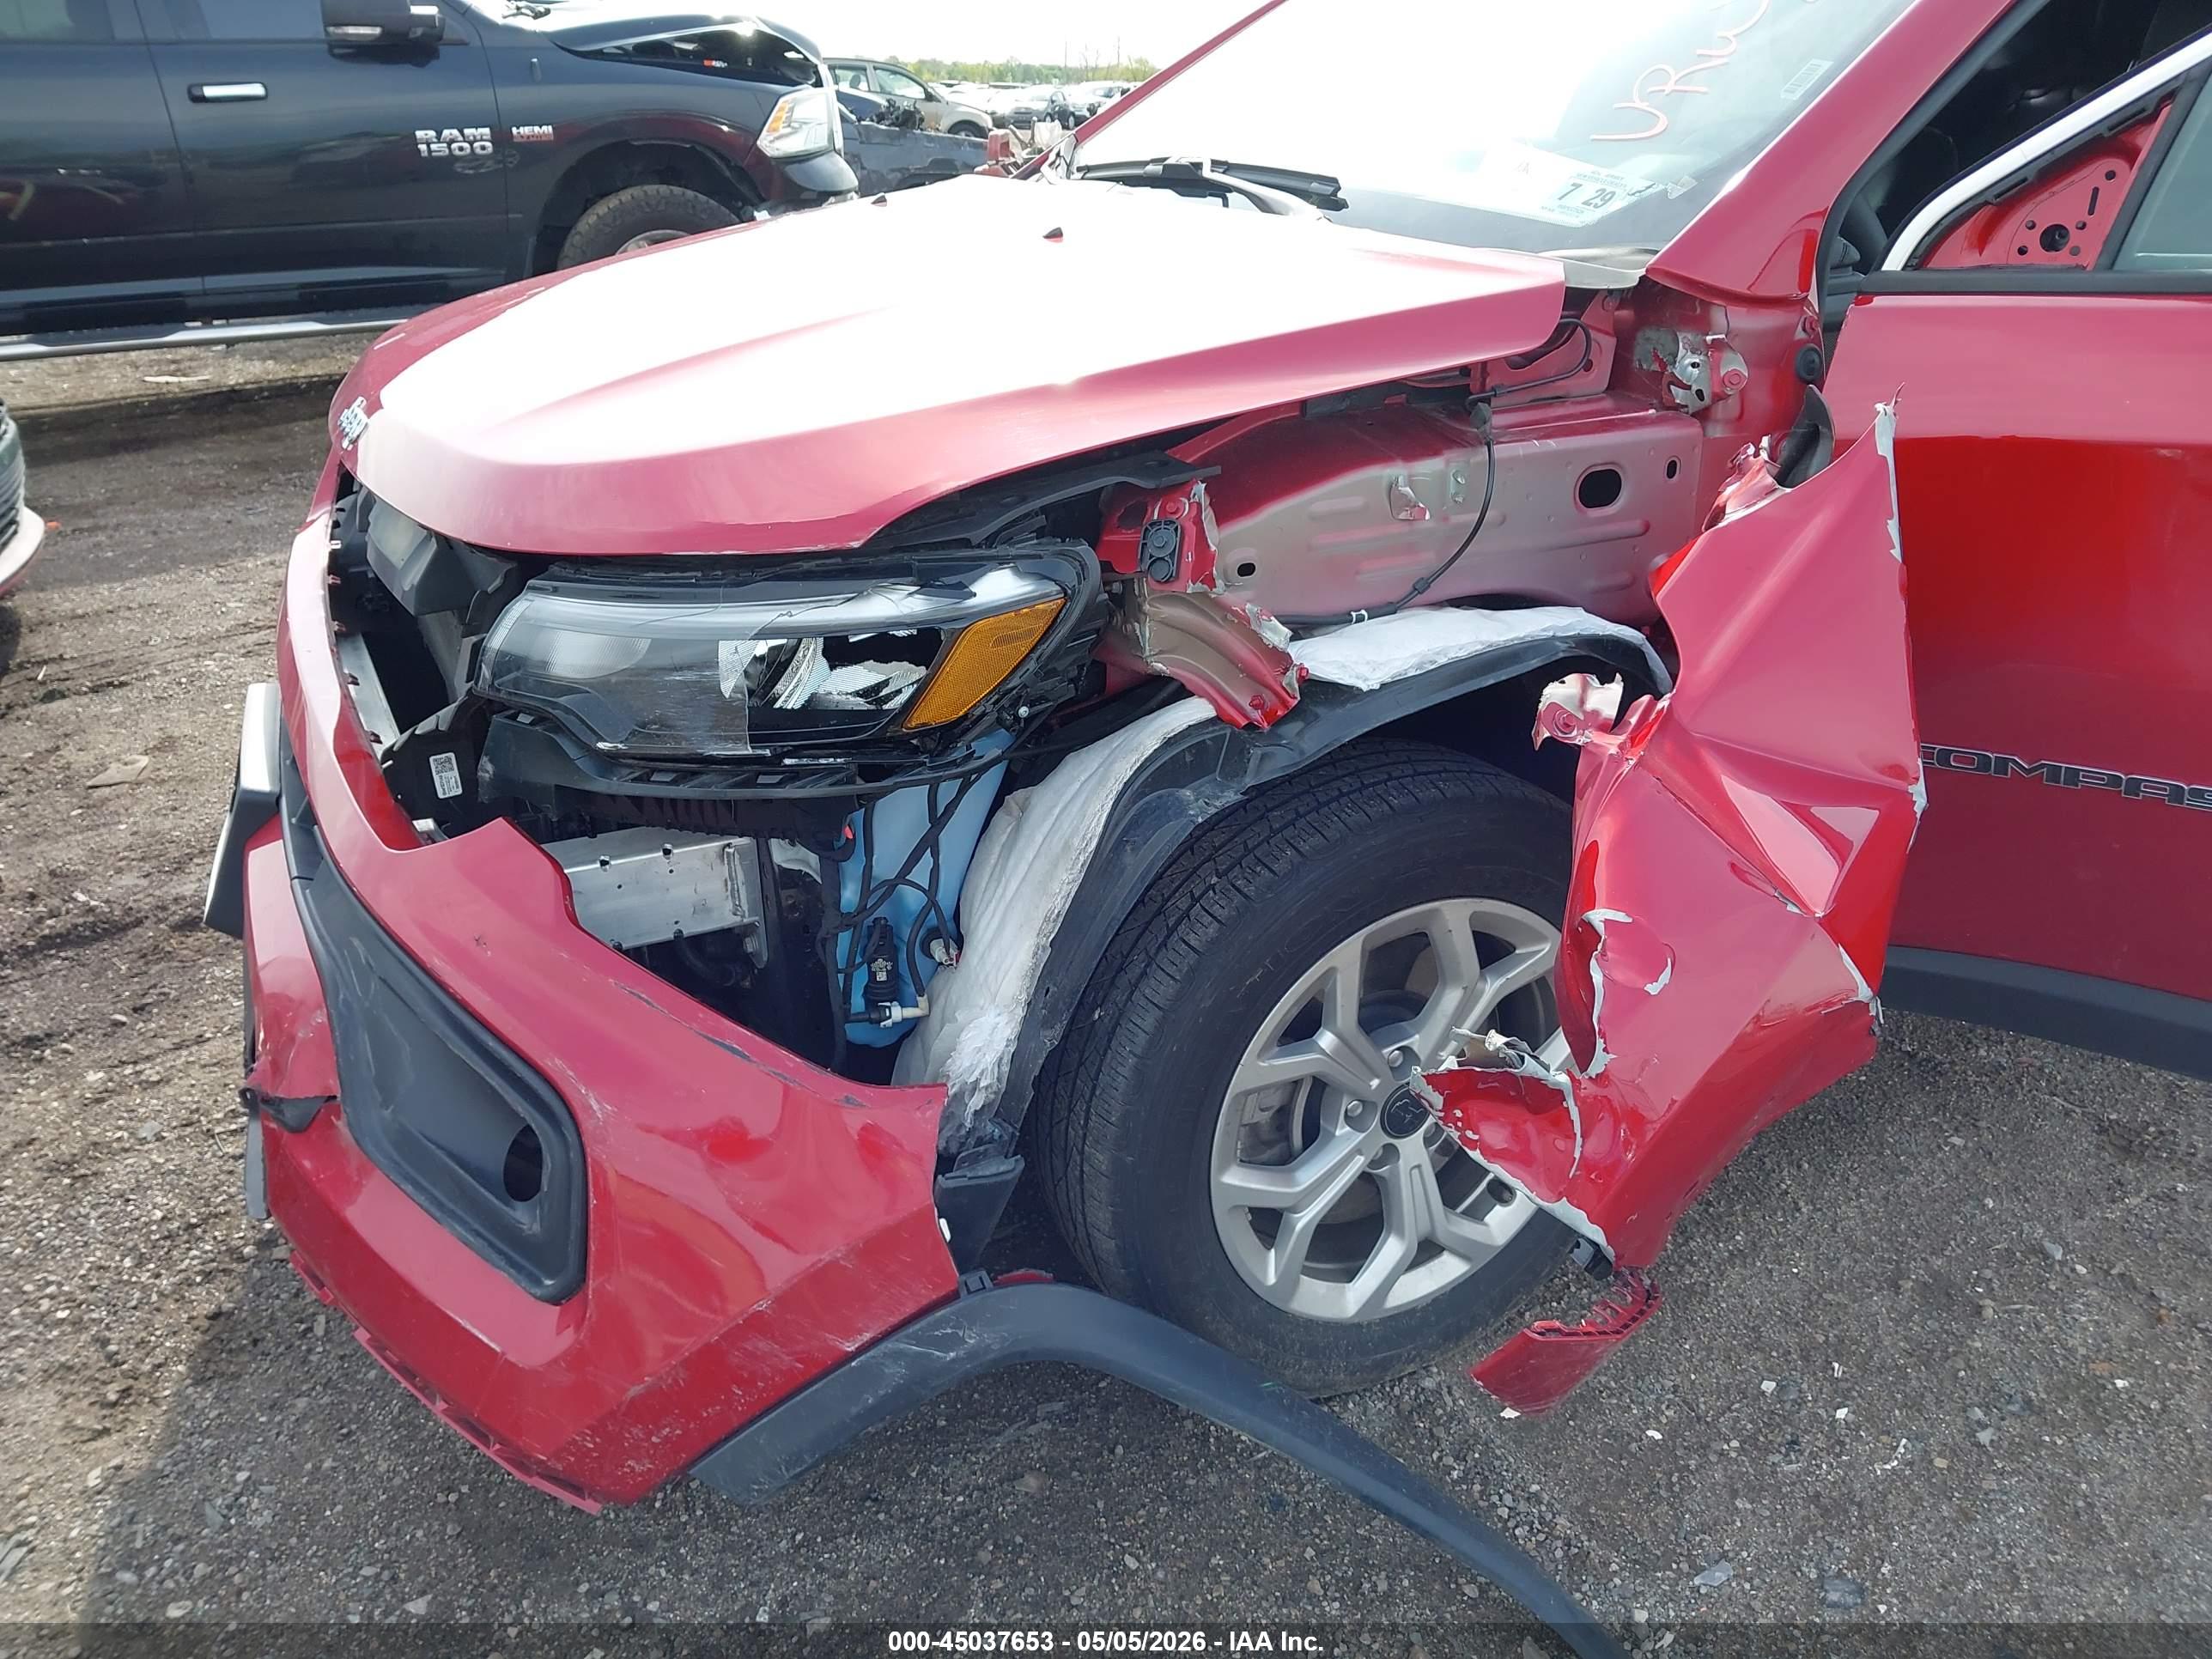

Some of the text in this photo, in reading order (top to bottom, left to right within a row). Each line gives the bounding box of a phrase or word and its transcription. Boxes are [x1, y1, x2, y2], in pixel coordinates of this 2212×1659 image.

[414, 127, 492, 143] RAM
[511, 125, 553, 136] HEMI
[417, 141, 494, 157] 1500
[1557, 182, 1617, 209] 7 29
[1920, 743, 2212, 812] OMPA
